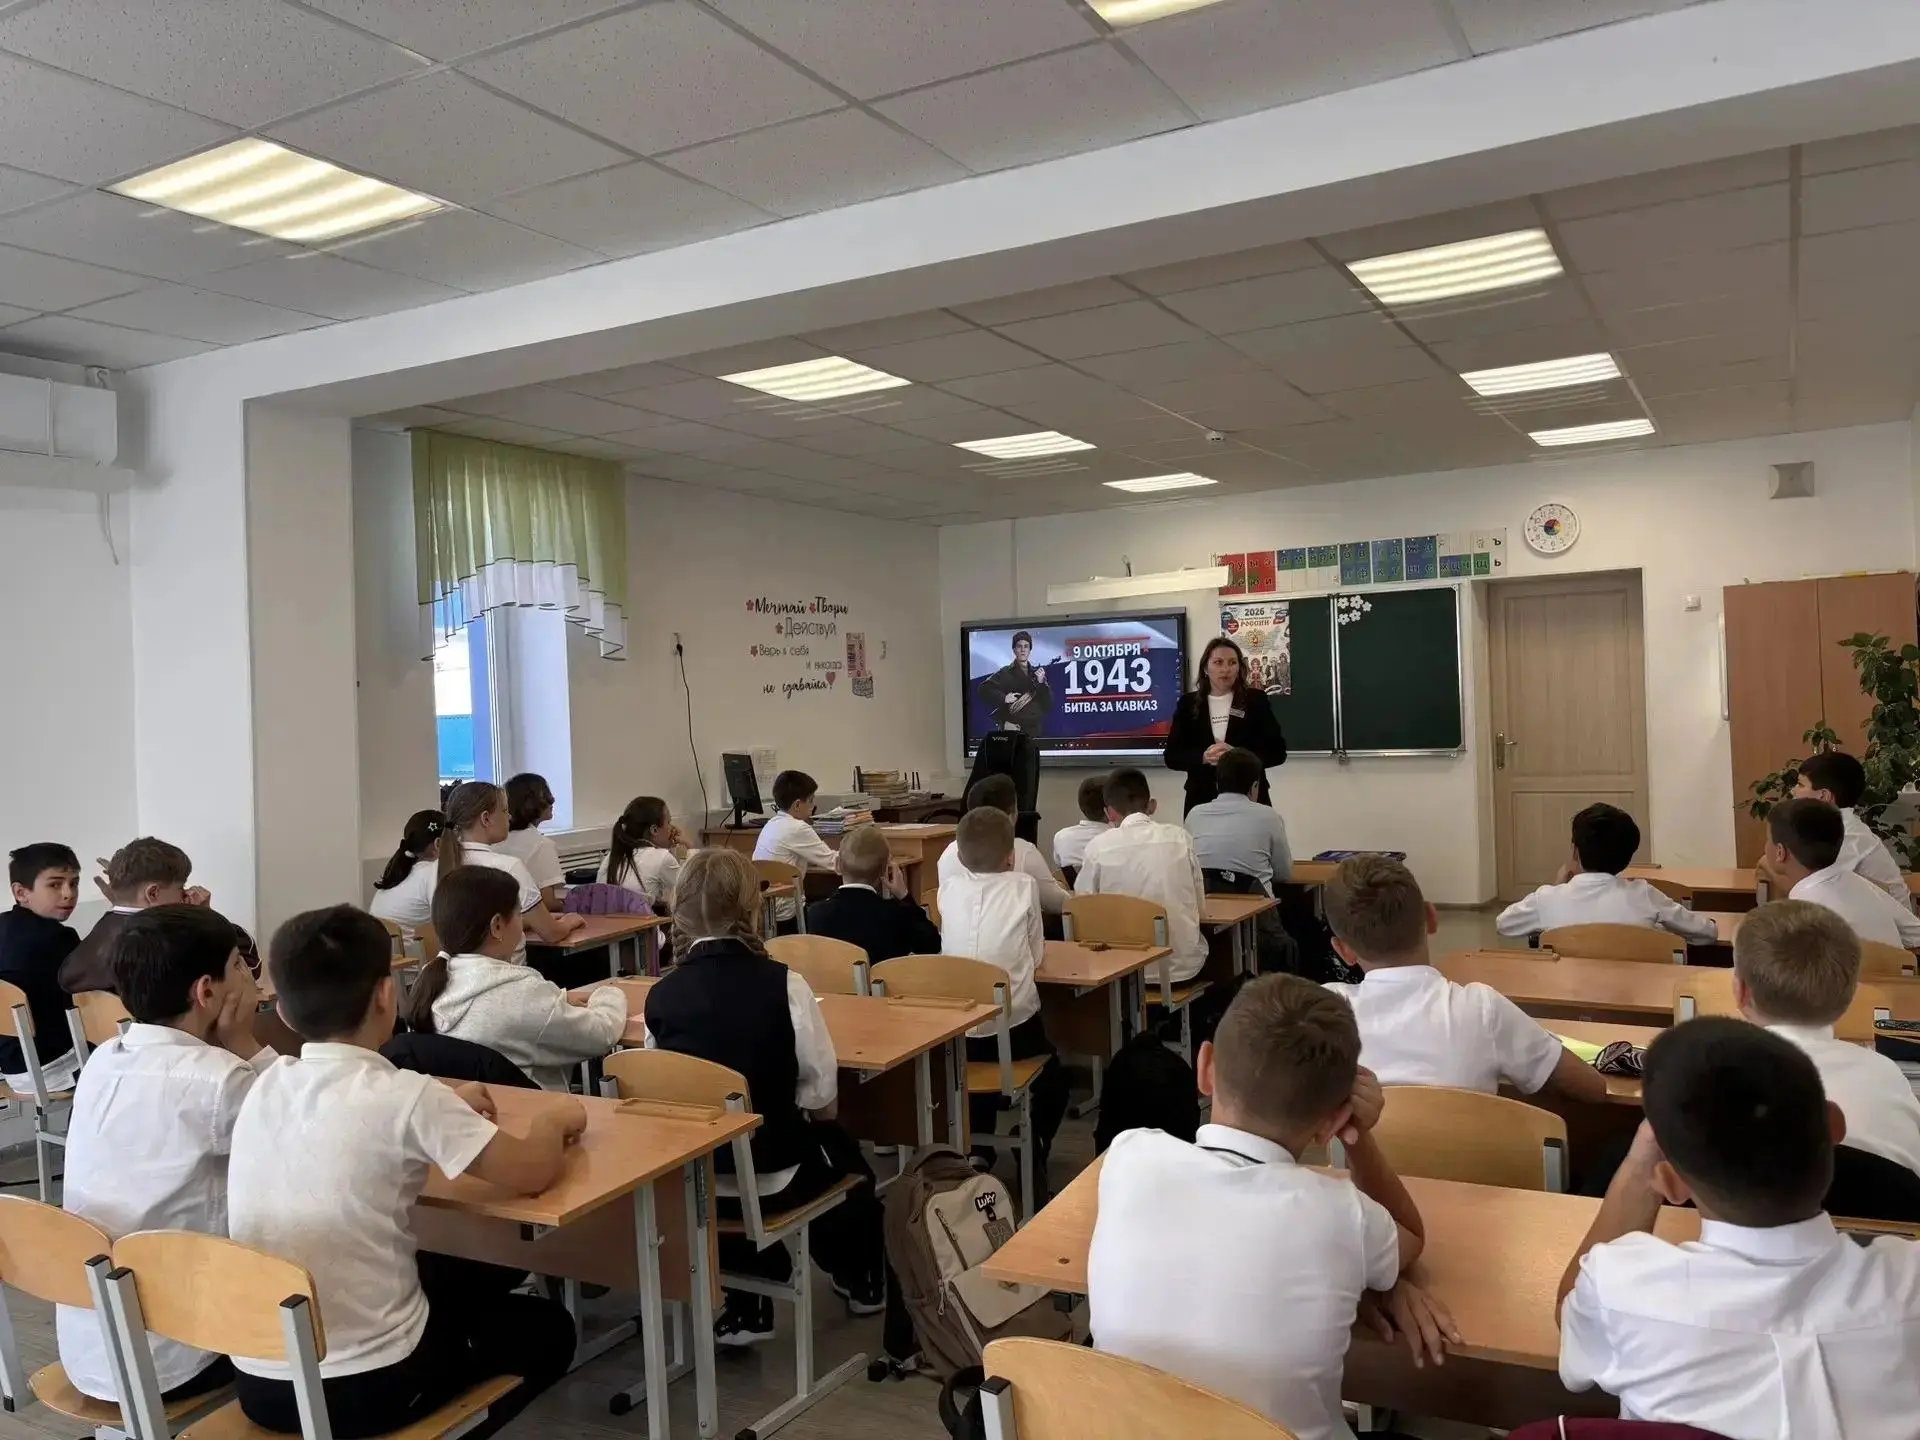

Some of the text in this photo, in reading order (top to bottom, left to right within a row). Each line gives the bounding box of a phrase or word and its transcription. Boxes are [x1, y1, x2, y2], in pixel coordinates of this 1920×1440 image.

[755, 596, 808, 616] Мечтай
[1244, 607, 1265, 617] 2026
[784, 616, 837, 639] Действуй
[1073, 642, 1141, 658] 9 ОКТЯБРЯ
[1064, 657, 1152, 695] 1943
[1064, 699, 1158, 713] БИТВА ЗА КАВКАЗ
